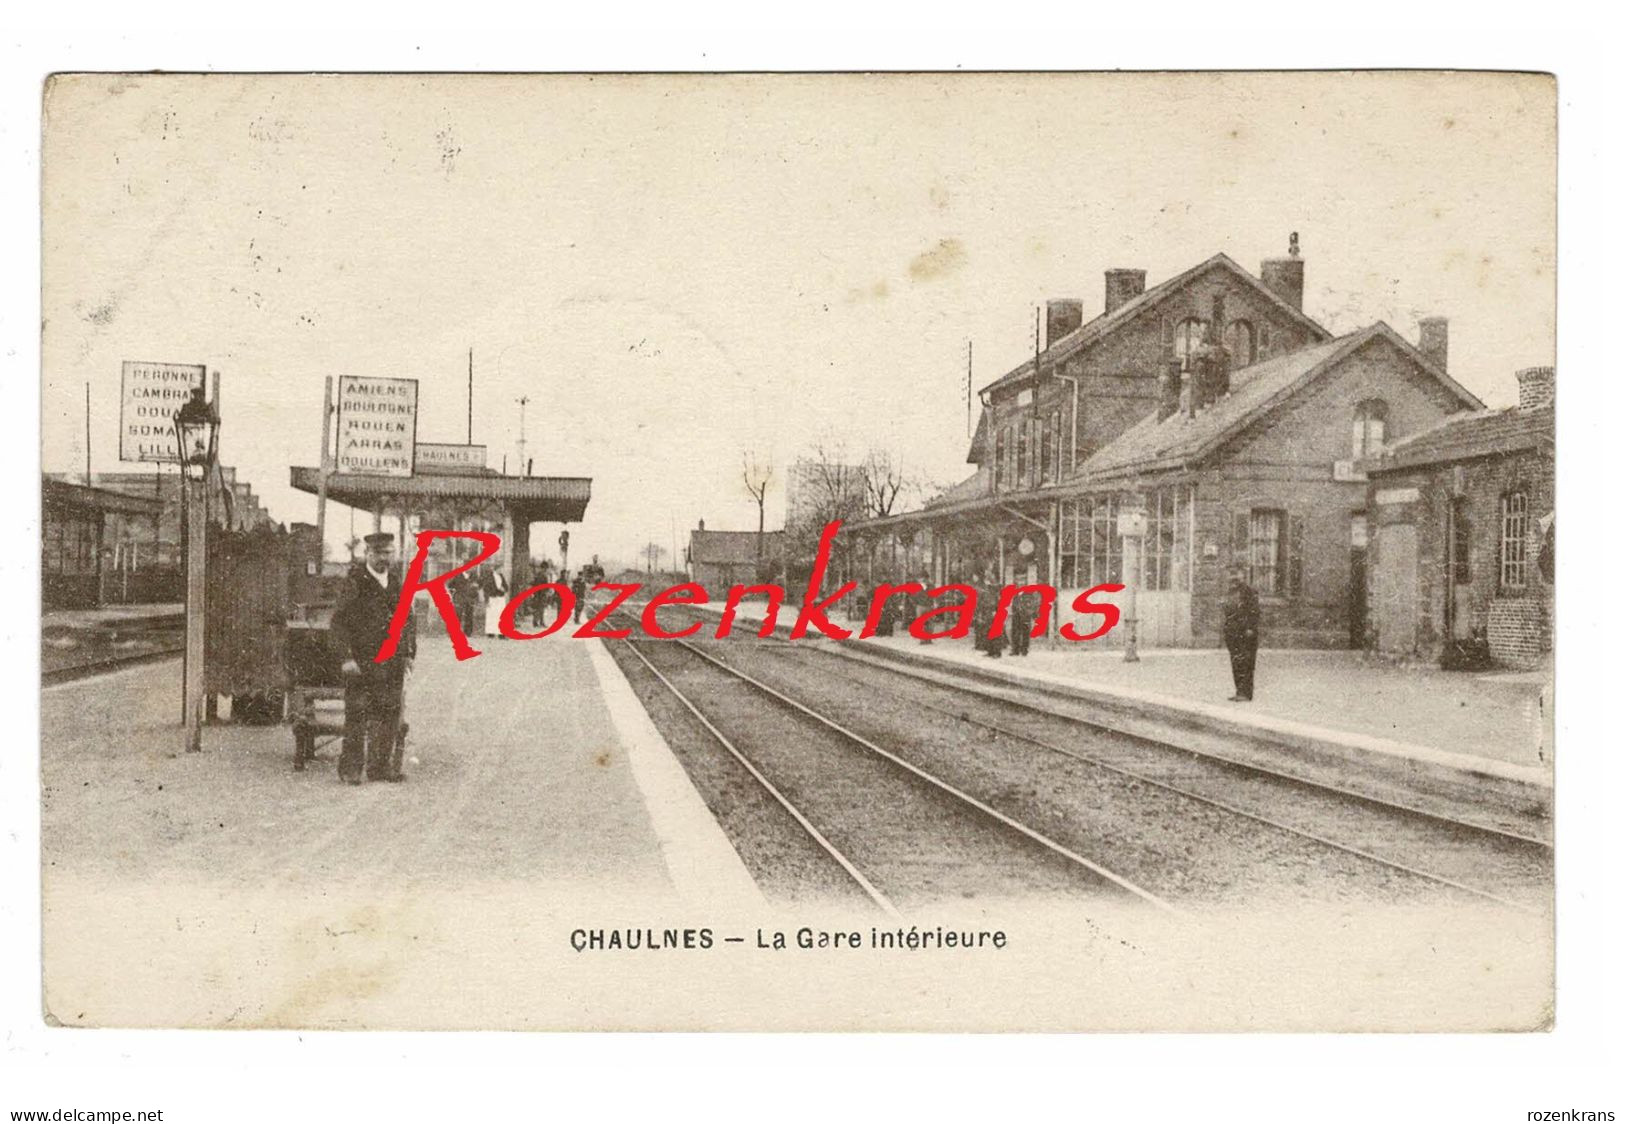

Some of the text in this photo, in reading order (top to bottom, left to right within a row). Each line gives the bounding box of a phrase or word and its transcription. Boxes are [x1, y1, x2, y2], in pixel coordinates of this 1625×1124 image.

[347, 384, 407, 397] AMIENS
[137, 406, 181, 419] DOUA
[343, 401, 414, 415] BOULOGNE
[129, 425, 191, 437] SOMA
[348, 420, 405, 433] ROUEN
[138, 443, 177, 455] LILL
[348, 439, 402, 450] ARRAS
[341, 456, 409, 469] DOULLENS
